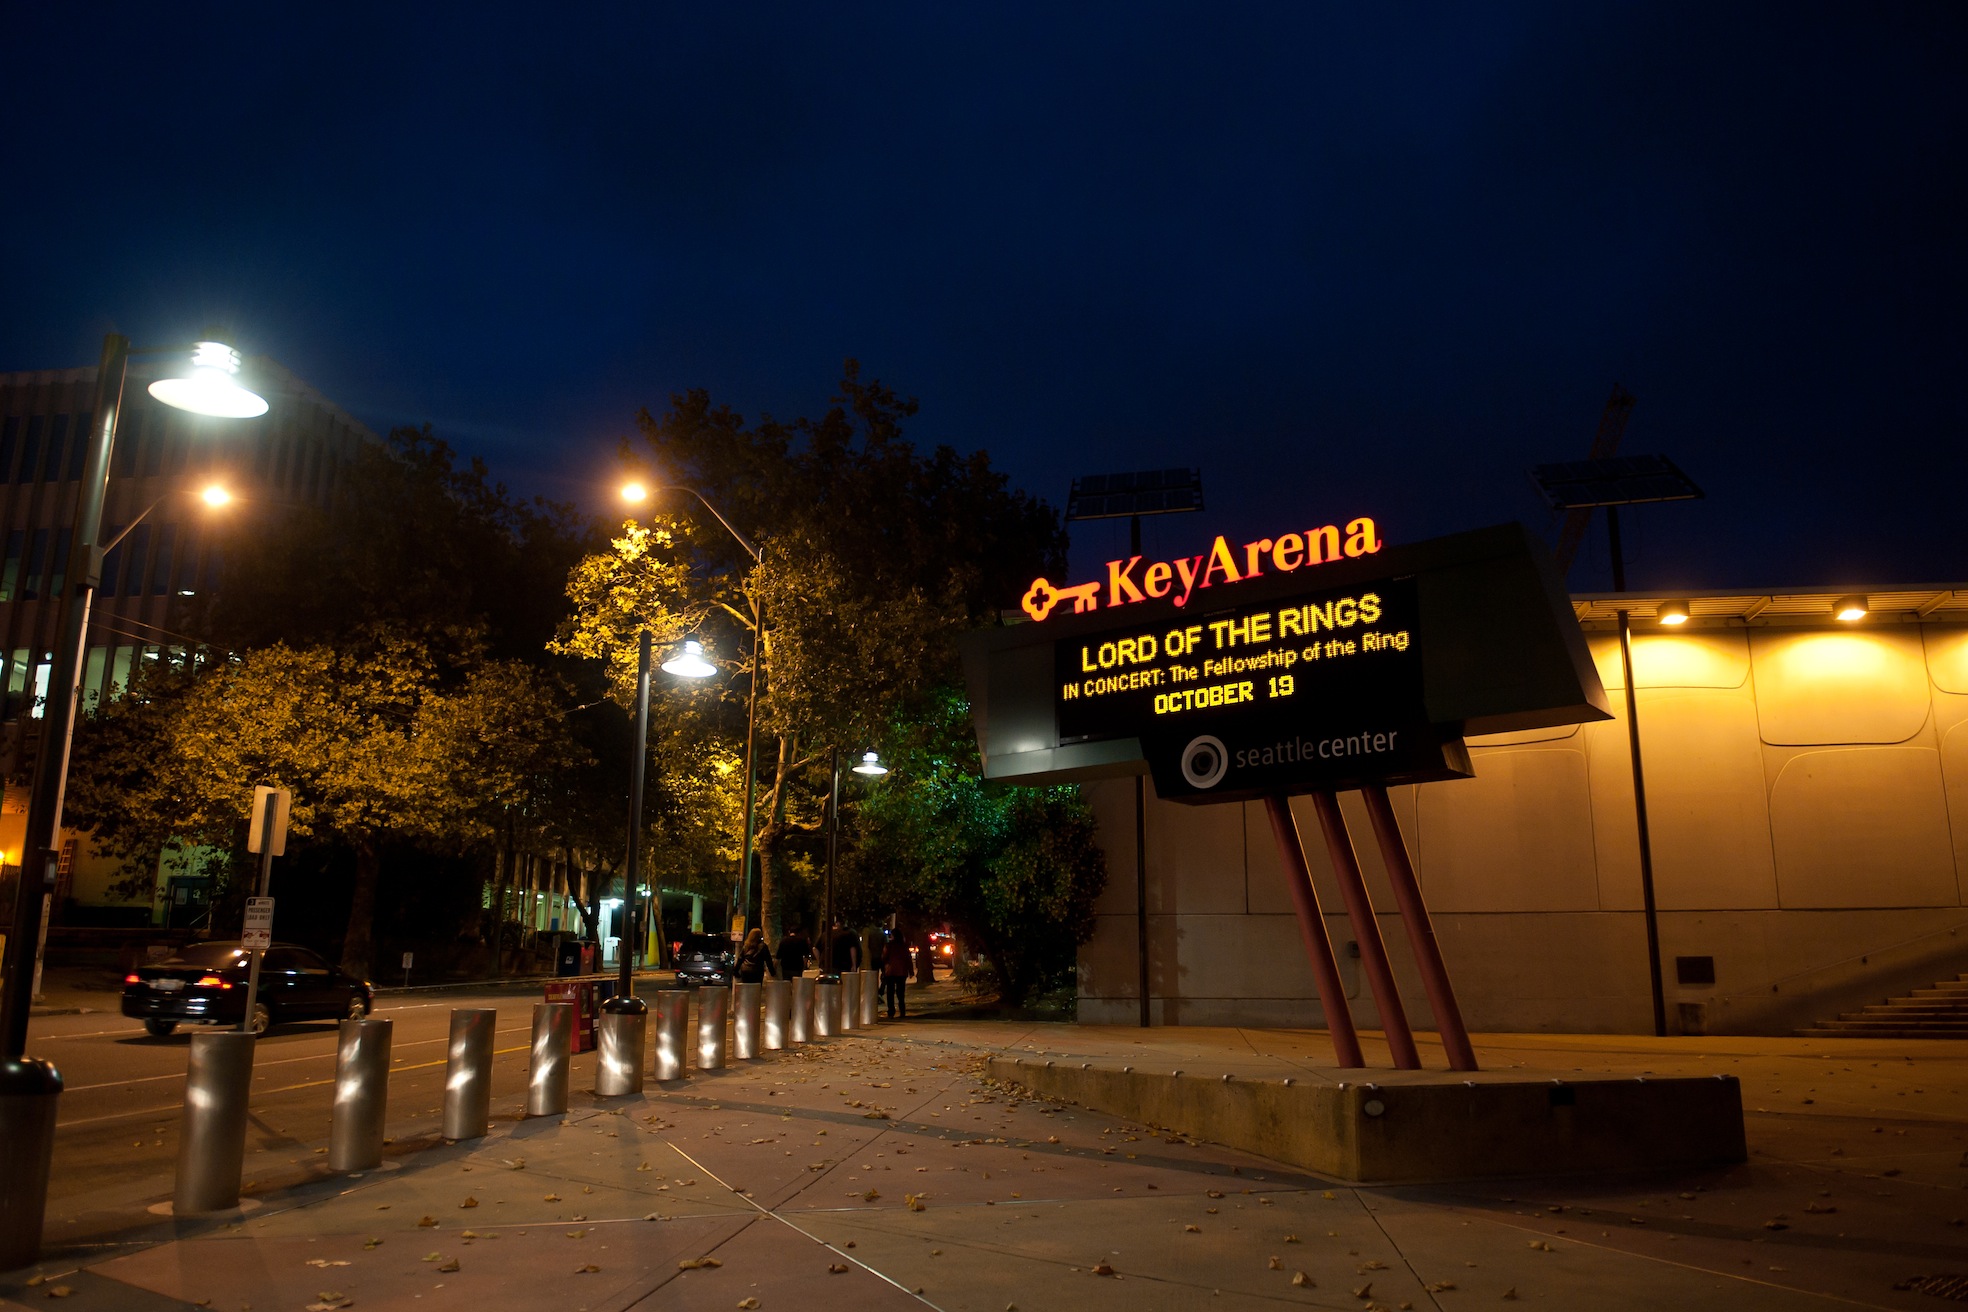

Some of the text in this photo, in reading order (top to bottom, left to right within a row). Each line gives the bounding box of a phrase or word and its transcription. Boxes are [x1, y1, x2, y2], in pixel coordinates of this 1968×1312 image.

[1106, 516, 1382, 608] KeyArena
[1063, 630, 1410, 701] IN CONCERT: The Fellowship of the Ring
[1081, 592, 1382, 673] LORD OF THE RINGS
[1154, 674, 1295, 715] OCTOBER 19
[1236, 731, 1398, 768] seattle center
